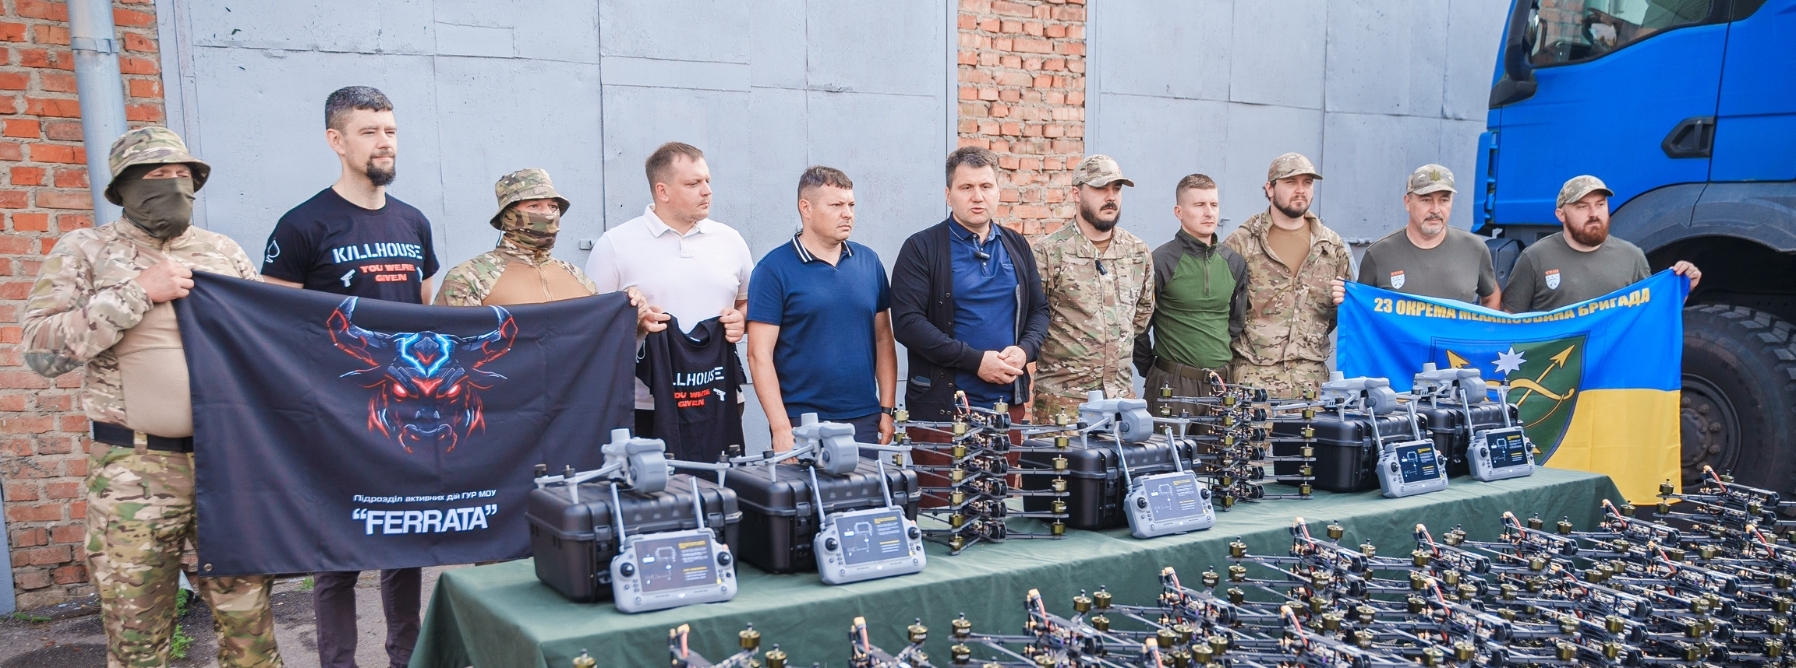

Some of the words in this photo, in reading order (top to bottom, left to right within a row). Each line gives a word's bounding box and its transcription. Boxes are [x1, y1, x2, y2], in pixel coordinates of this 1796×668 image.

[332, 242, 423, 263] KILLHOUSE
[360, 264, 383, 273] YOU
[384, 263, 415, 272] WERE
[375, 273, 408, 282] GIVEN
[1374, 297, 1393, 313] 23
[1396, 299, 1457, 319] ОКРЕМА
[1578, 287, 1650, 316] БРИГАДА
[673, 366, 725, 386] LHOUSE
[678, 399, 705, 408] GIVEN
[353, 494, 403, 503] Підрозділ
[405, 494, 445, 503] активних
[446, 492, 460, 502] дій
[461, 490, 477, 499] ГУР
[478, 489, 497, 498] МОУ
[352, 504, 498, 535] “FERRATA”
